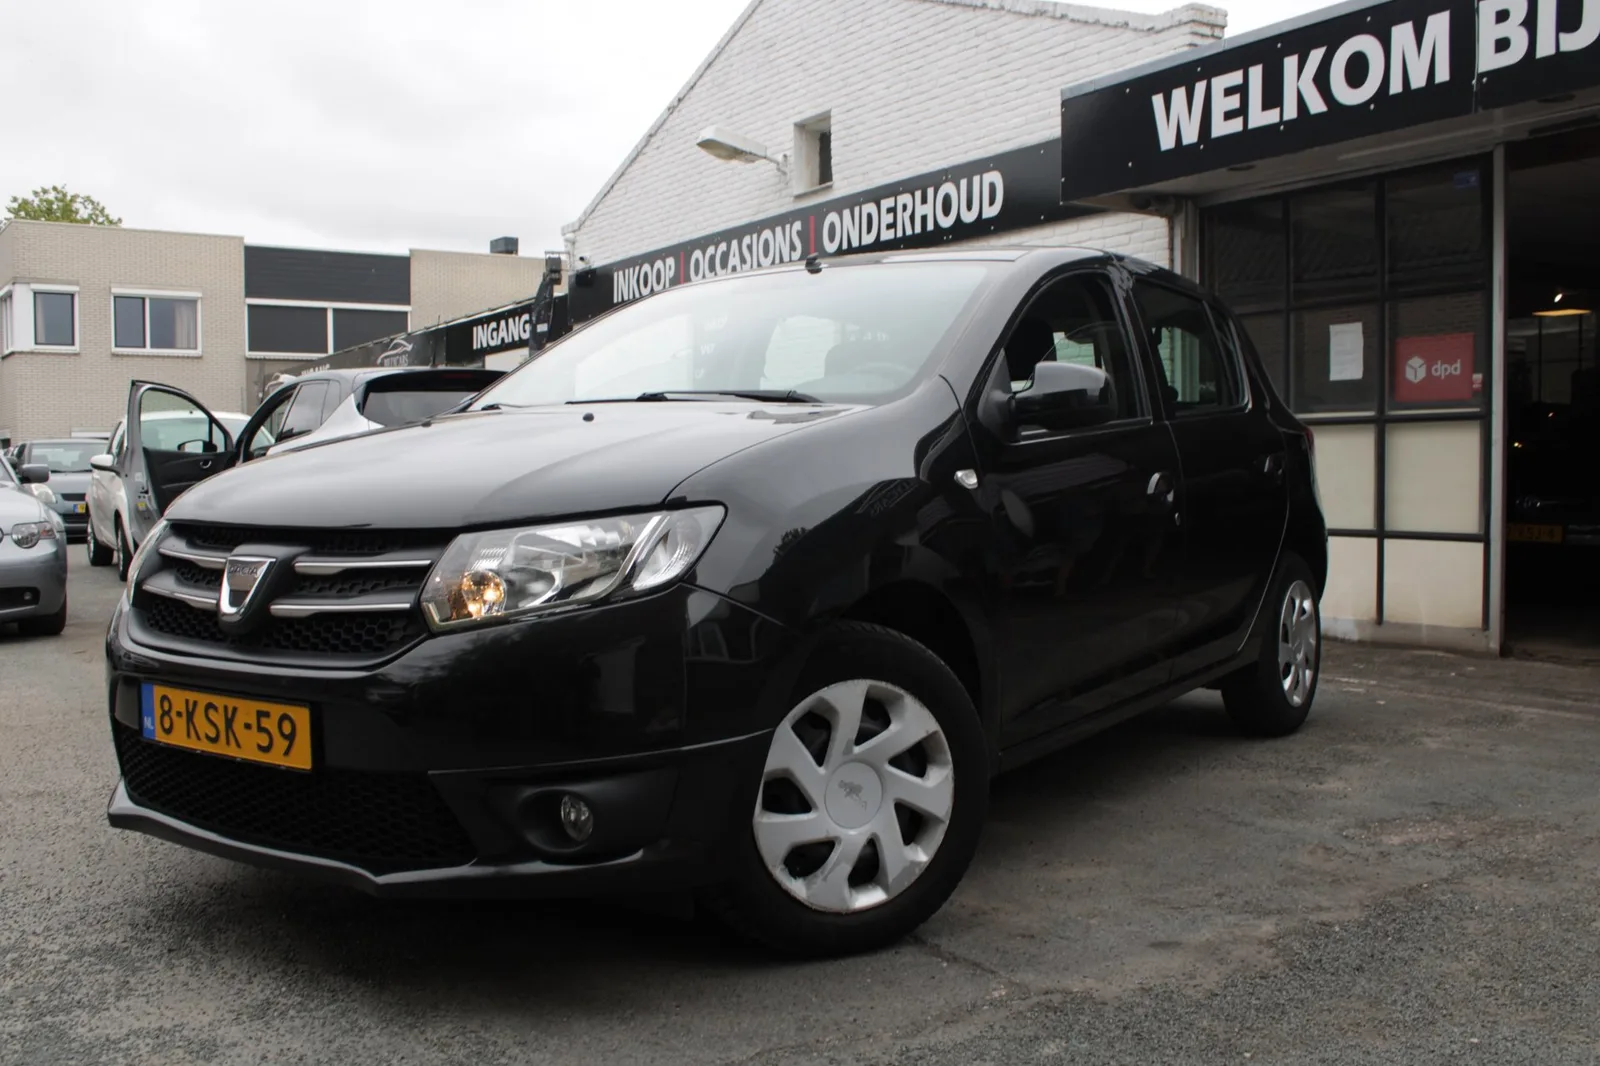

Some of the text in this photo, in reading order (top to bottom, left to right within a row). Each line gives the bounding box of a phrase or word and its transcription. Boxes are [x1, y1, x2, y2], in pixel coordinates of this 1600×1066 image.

[1152, 0, 1600, 152] WELKOM BIJ
[613, 171, 1004, 303] INKOOP OCCASIONS ONDERHOUD
[472, 313, 530, 350] INGANG
[1431, 359, 1461, 379] dpd
[144, 716, 154, 729] NL
[159, 694, 297, 756] 8-KSK-59
